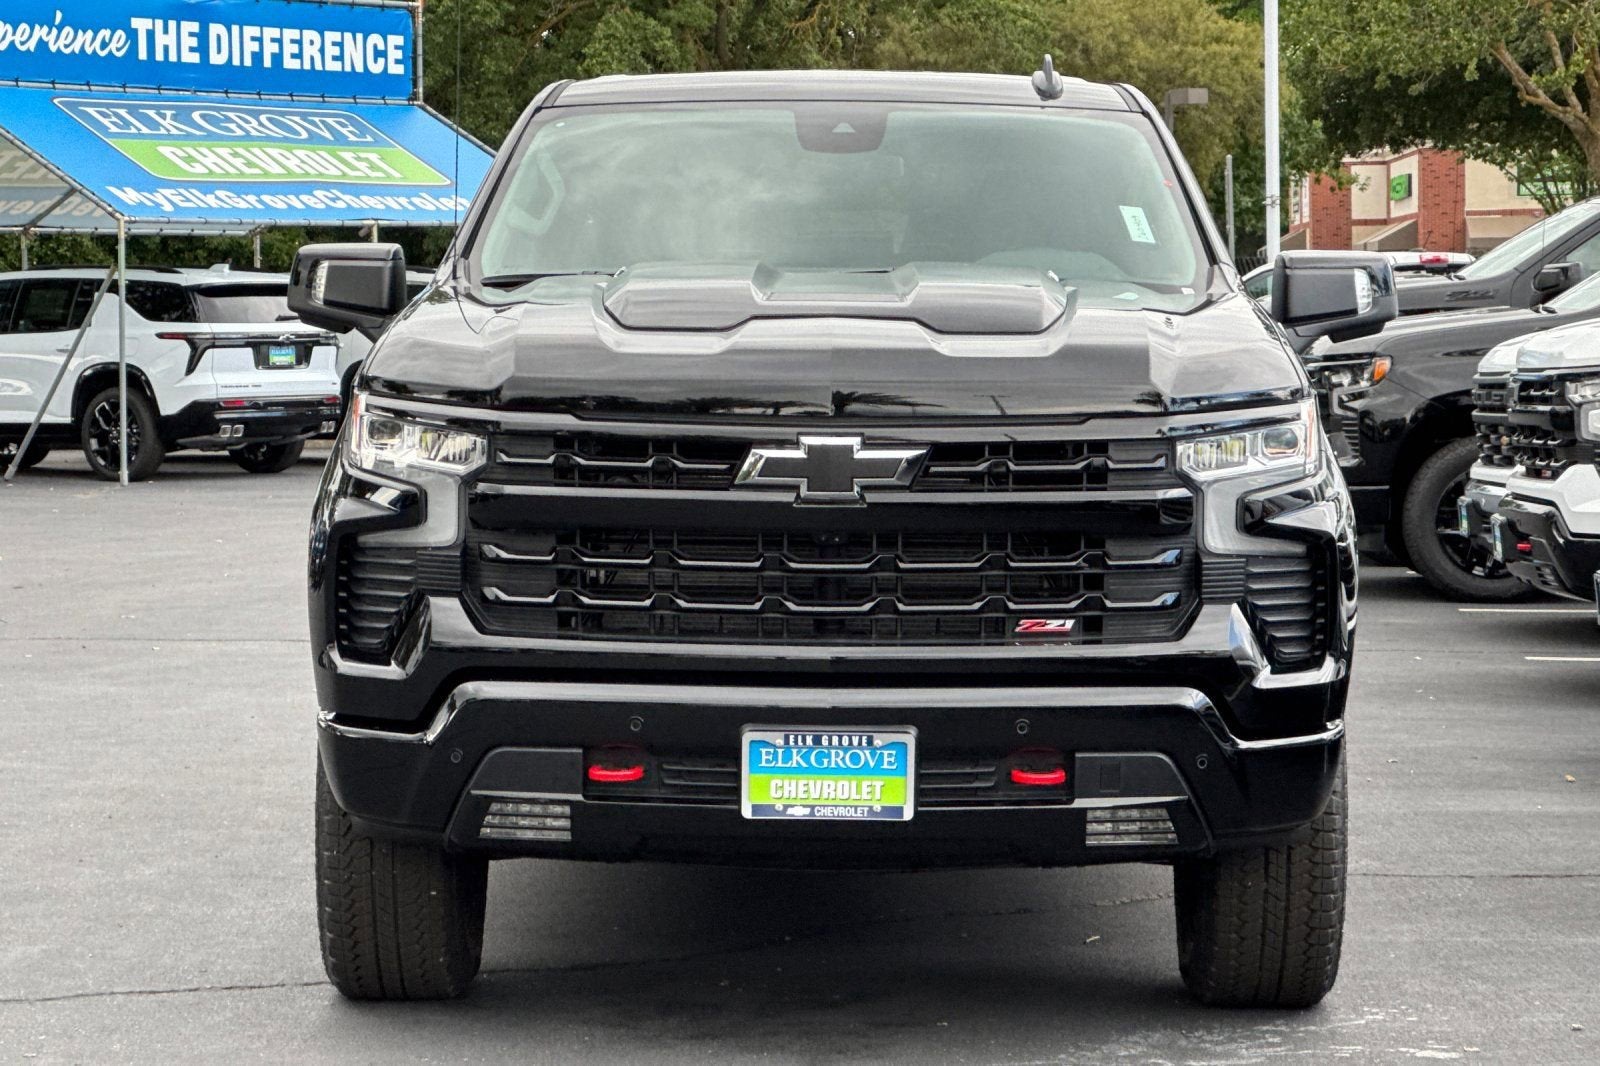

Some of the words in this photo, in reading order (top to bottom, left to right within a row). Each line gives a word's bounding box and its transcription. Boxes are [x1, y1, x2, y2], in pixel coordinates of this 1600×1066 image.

[130, 17, 200, 63] THE
[208, 23, 405, 75] DIFFERENCE
[78, 106, 207, 135] ELK
[192, 110, 374, 142] GROVE
[156, 145, 404, 178] CHEVROLET
[789, 735, 813, 746] ELK
[821, 735, 868, 746] GROVE
[759, 748, 809, 768] ELK
[810, 748, 898, 770] GROVE
[769, 779, 885, 800] CHEVROLET
[814, 806, 869, 817] CHEVROLET
